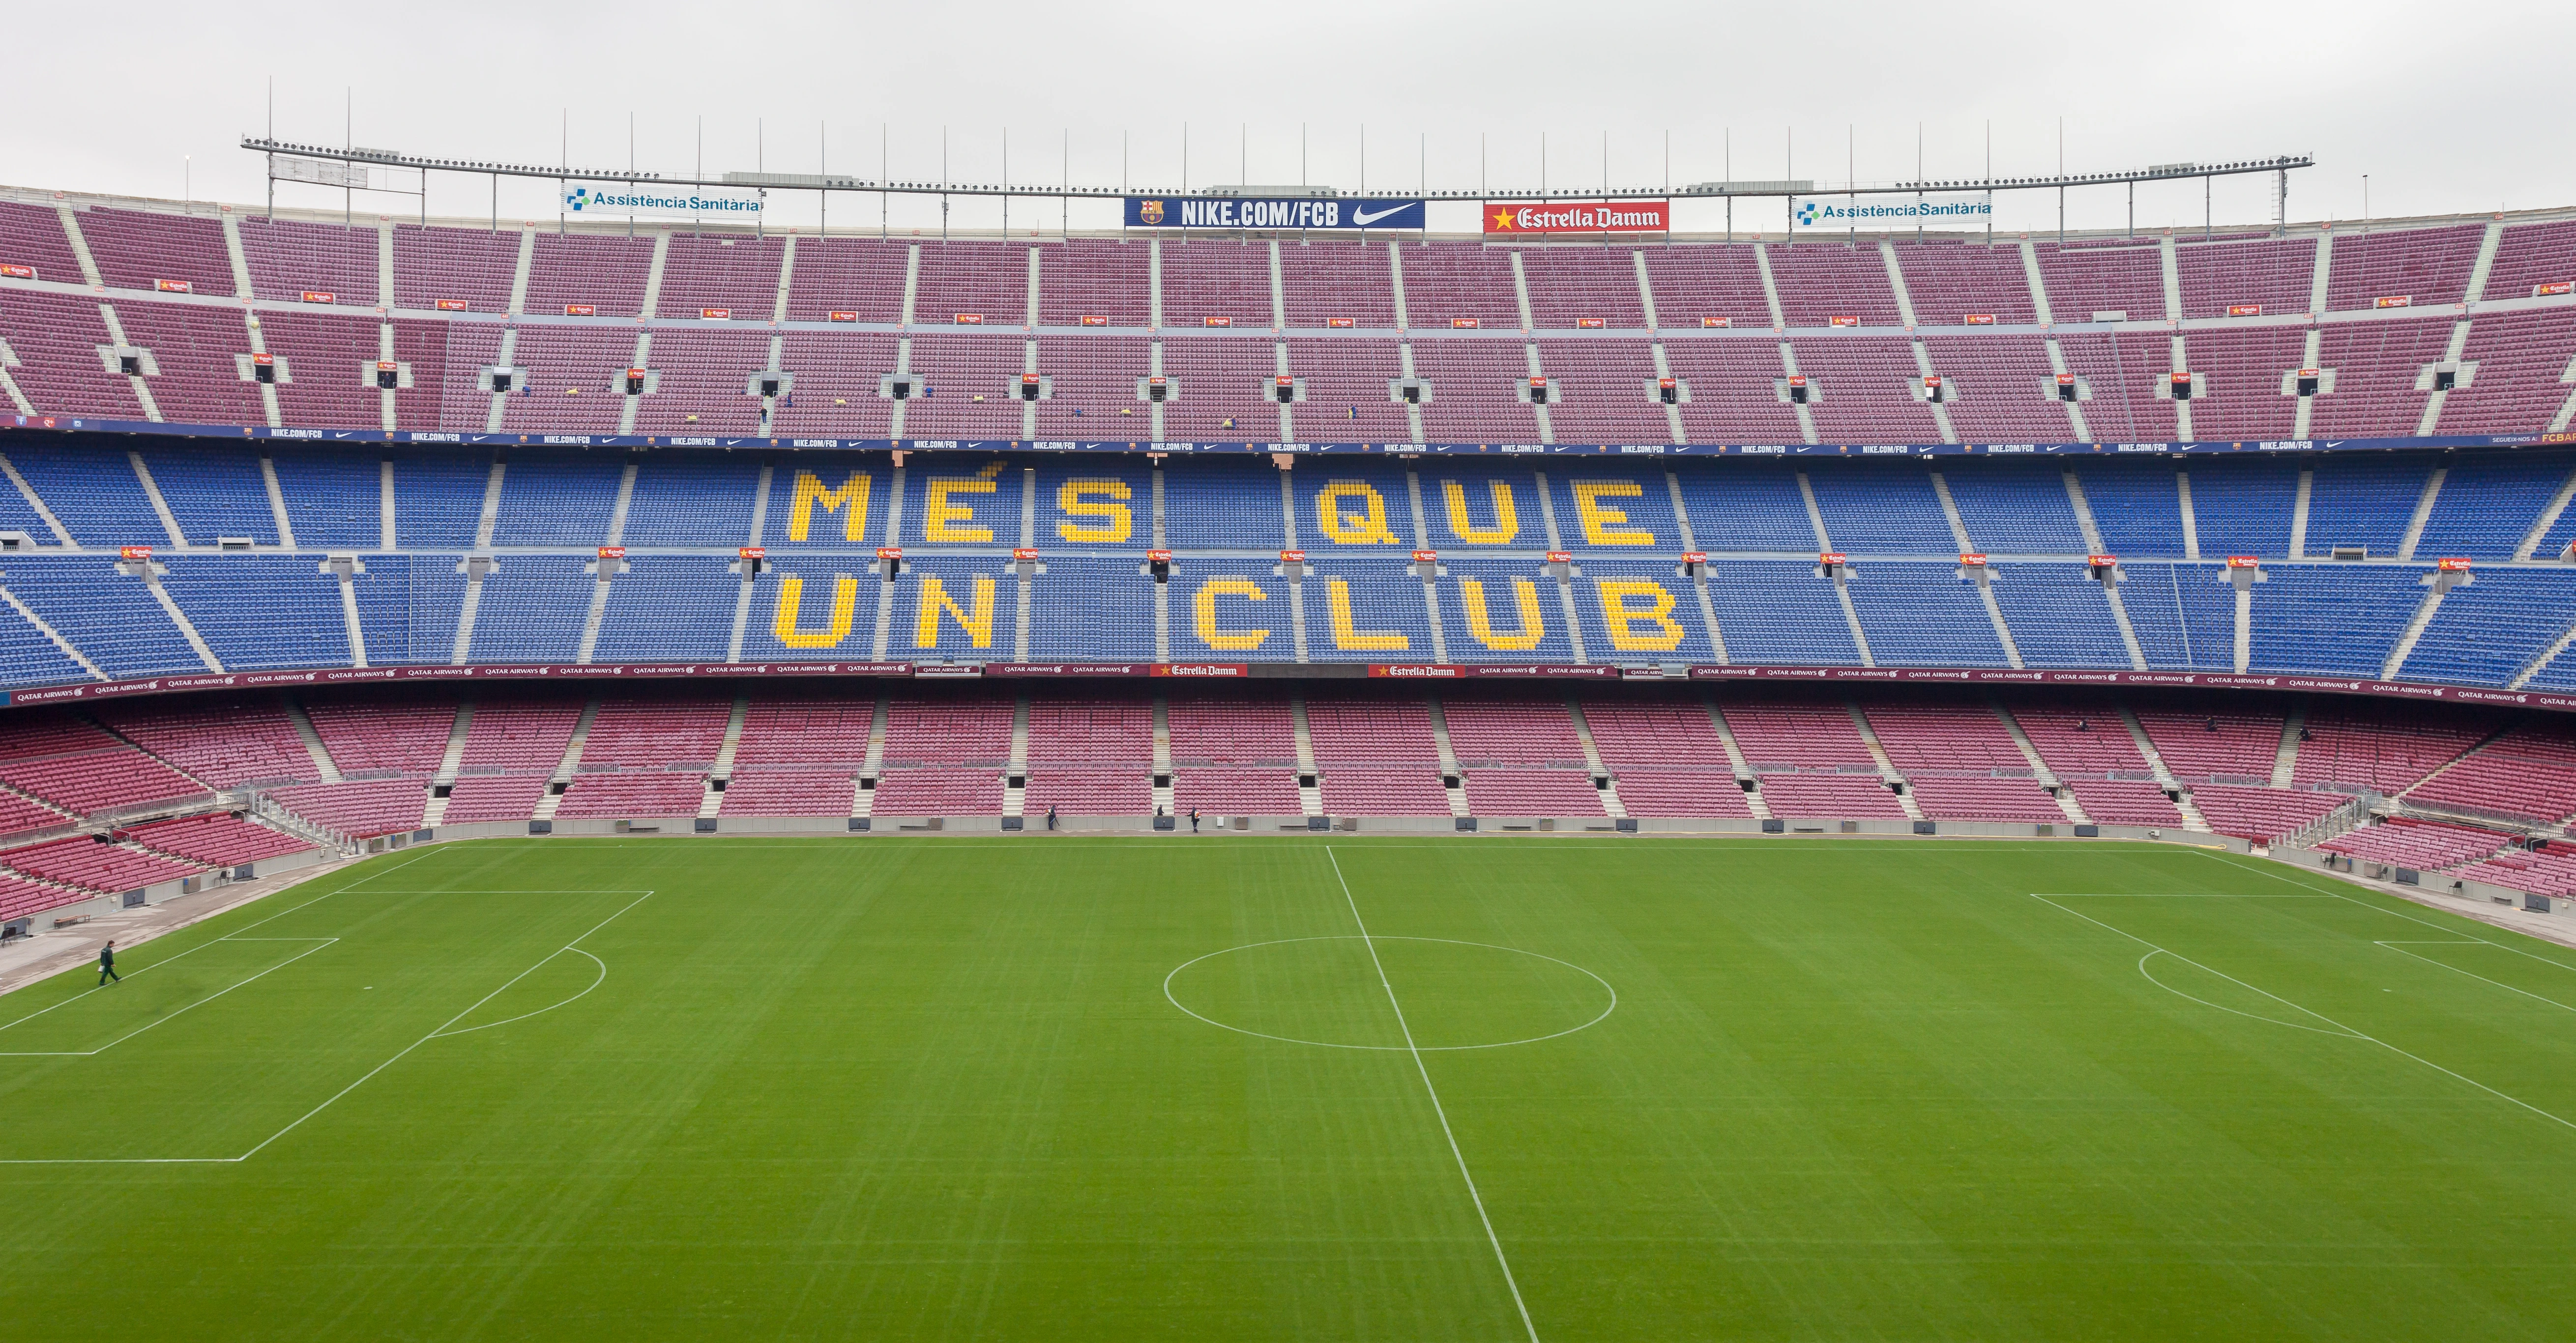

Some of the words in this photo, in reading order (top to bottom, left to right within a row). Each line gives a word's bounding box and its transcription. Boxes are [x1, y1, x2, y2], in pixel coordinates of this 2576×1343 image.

[594, 192, 686, 208] Assistència
[689, 196, 759, 211] Sanitària
[1182, 201, 1338, 226] NIKE.COM/FCB
[1517, 207, 1594, 229] Estrella
[1595, 208, 1660, 228] Damm
[1823, 204, 1916, 218] Assistència
[1919, 203, 1991, 215] Sanitària
[271, 429, 322, 438] NIKE.COM/FCB
[411, 433, 460, 441] NIKE.COM/FCB
[2260, 441, 2312, 450] NIKE.COM/FCB
[789, 461, 1131, 542] MÉS
[1317, 483, 1655, 545] QUE
[774, 579, 995, 648] UN
[1196, 580, 1685, 651] CLUB
[1171, 665, 1207, 675] Estrella
[1207, 665, 1237, 676] Damm
[1390, 665, 1425, 676] Estrella
[1425, 666, 1455, 676] Damm
